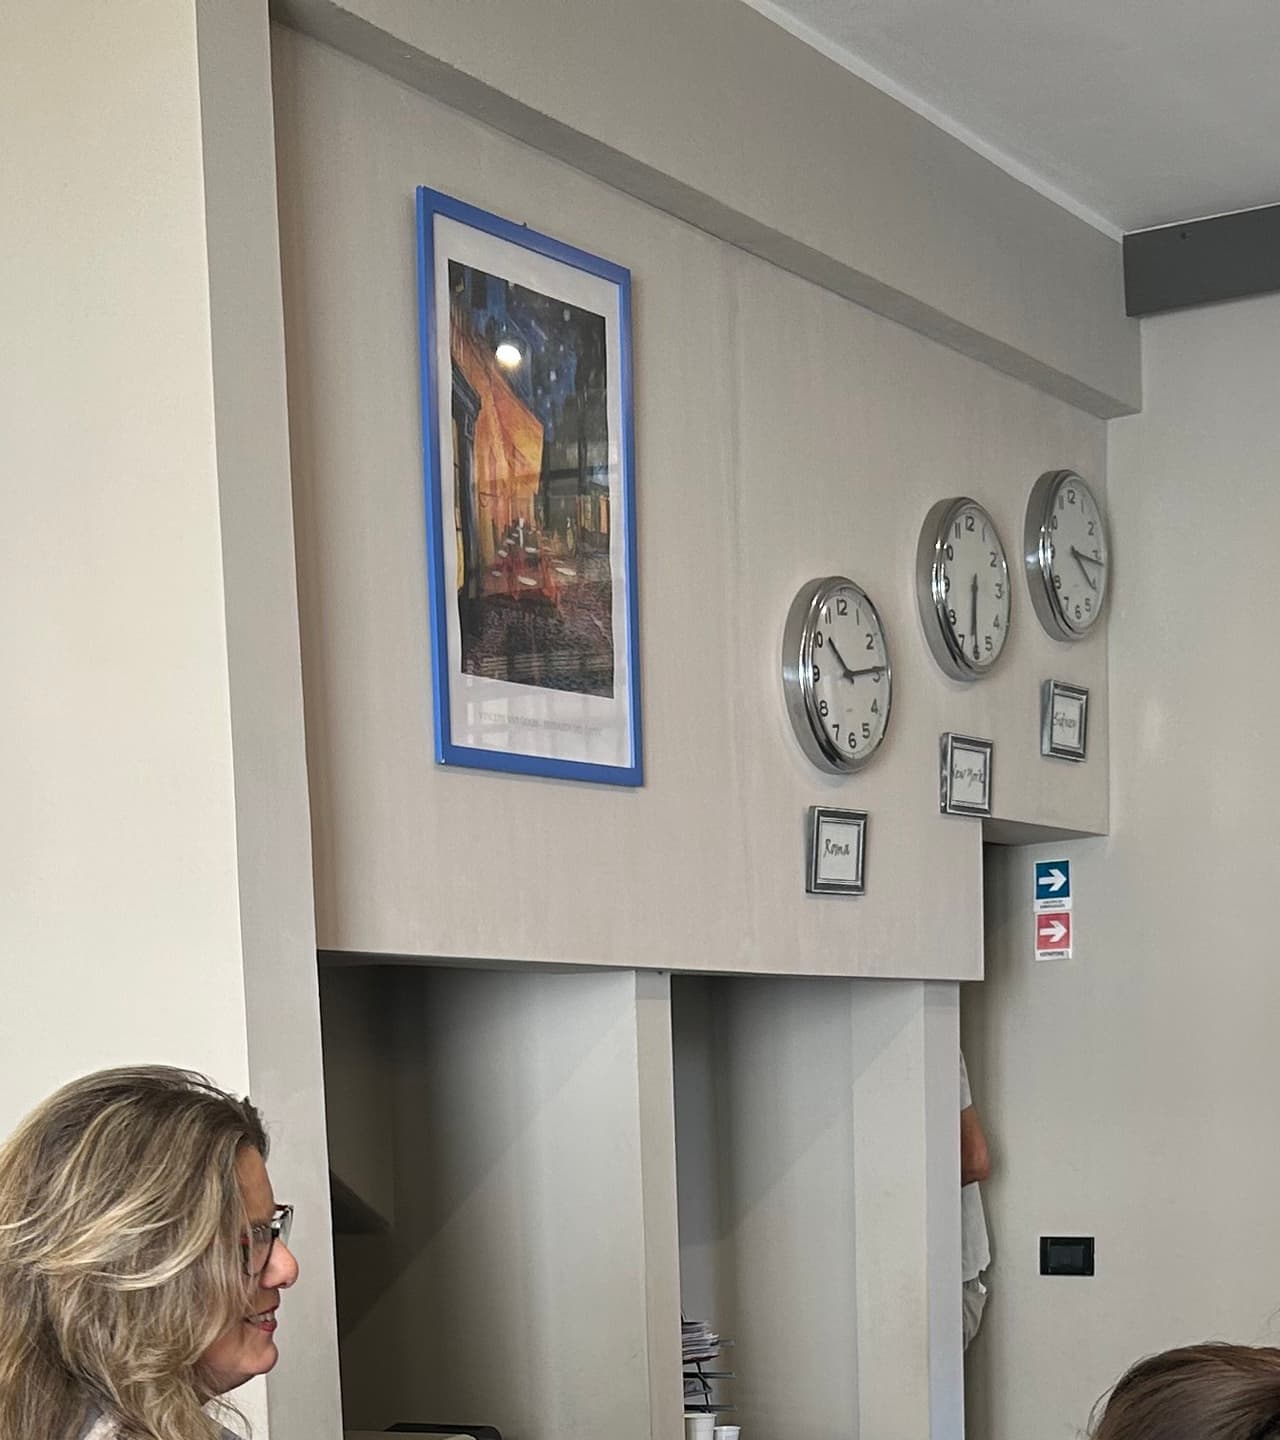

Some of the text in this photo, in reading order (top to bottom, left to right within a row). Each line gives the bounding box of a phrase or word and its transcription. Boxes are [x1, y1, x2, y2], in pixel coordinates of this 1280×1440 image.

[1067, 489, 1076, 504] 12
[954, 522, 961, 539] 11
[965, 515, 975, 532] 12
[1087, 521, 1095, 536] 2
[990, 552, 997, 568] 2
[995, 583, 1002, 599] 3
[825, 606, 831, 624] 11
[836, 599, 848, 616] 12
[1075, 605, 1082, 620] 6
[993, 614, 1000, 628] 4
[866, 634, 874, 650] 2
[985, 636, 993, 651] 5
[813, 665, 820, 682] 9
[820, 700, 829, 717] 8
[871, 699, 878, 715] 4
[832, 724, 840, 741] 7
[862, 723, 870, 739] 5
[848, 732, 857, 749] 6
